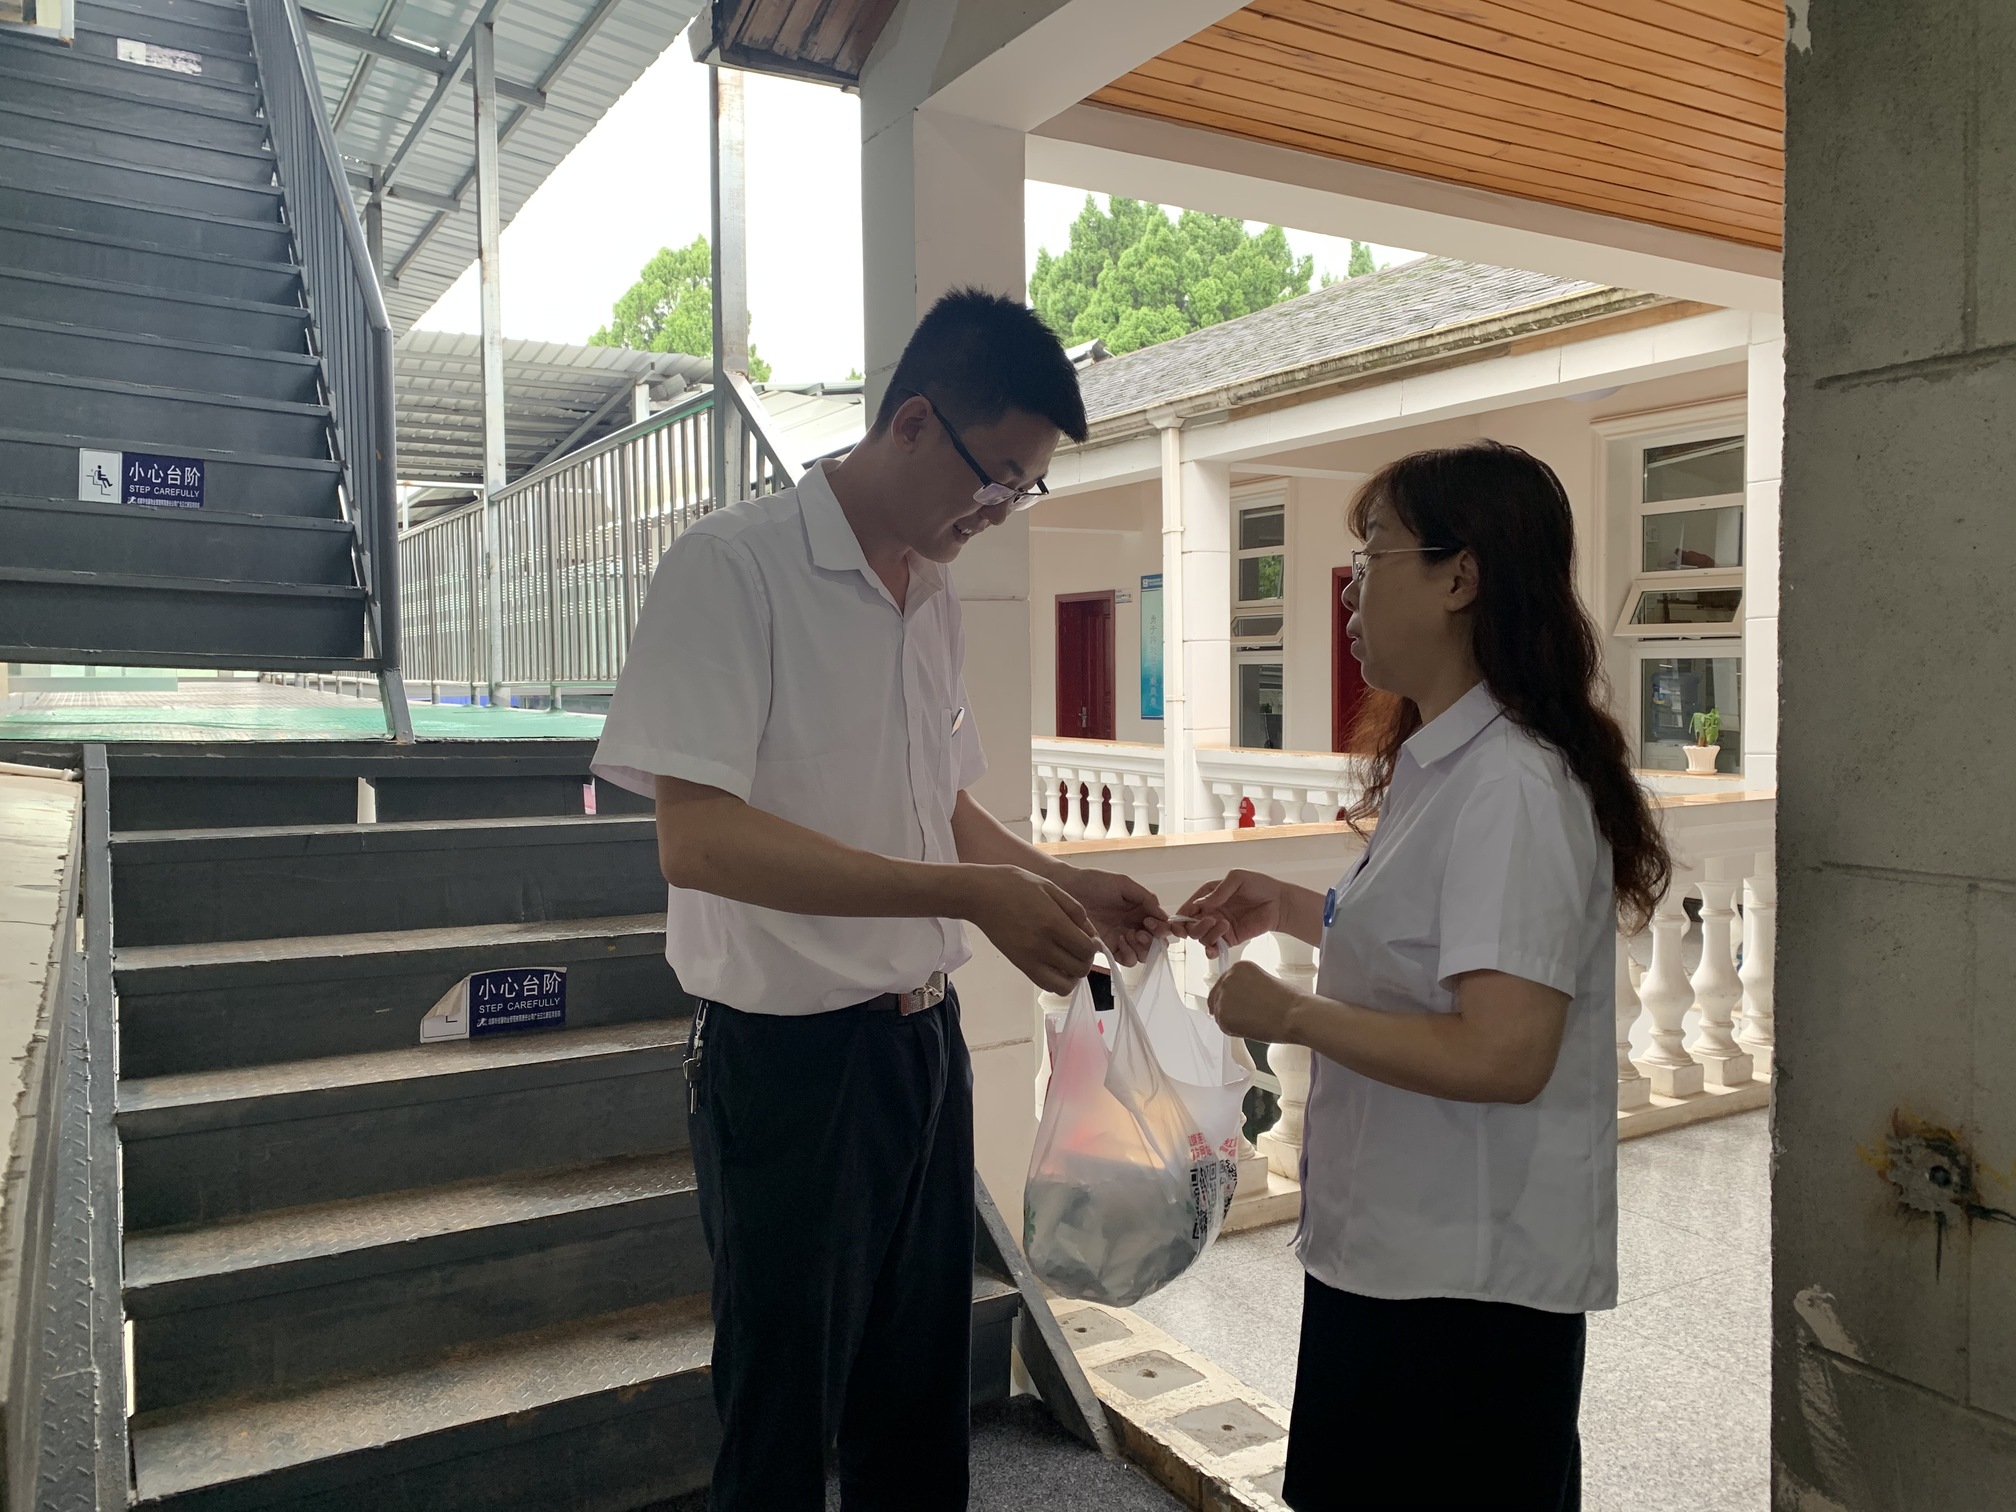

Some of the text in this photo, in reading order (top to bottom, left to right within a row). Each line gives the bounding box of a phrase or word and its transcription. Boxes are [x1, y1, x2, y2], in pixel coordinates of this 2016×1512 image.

[129, 462, 201, 486] 小心台阶
[129, 485, 200, 497] STEP CAREFULLY
[478, 972, 561, 1000] 小心台阶
[479, 998, 561, 1014] STEP CAREFULLY
